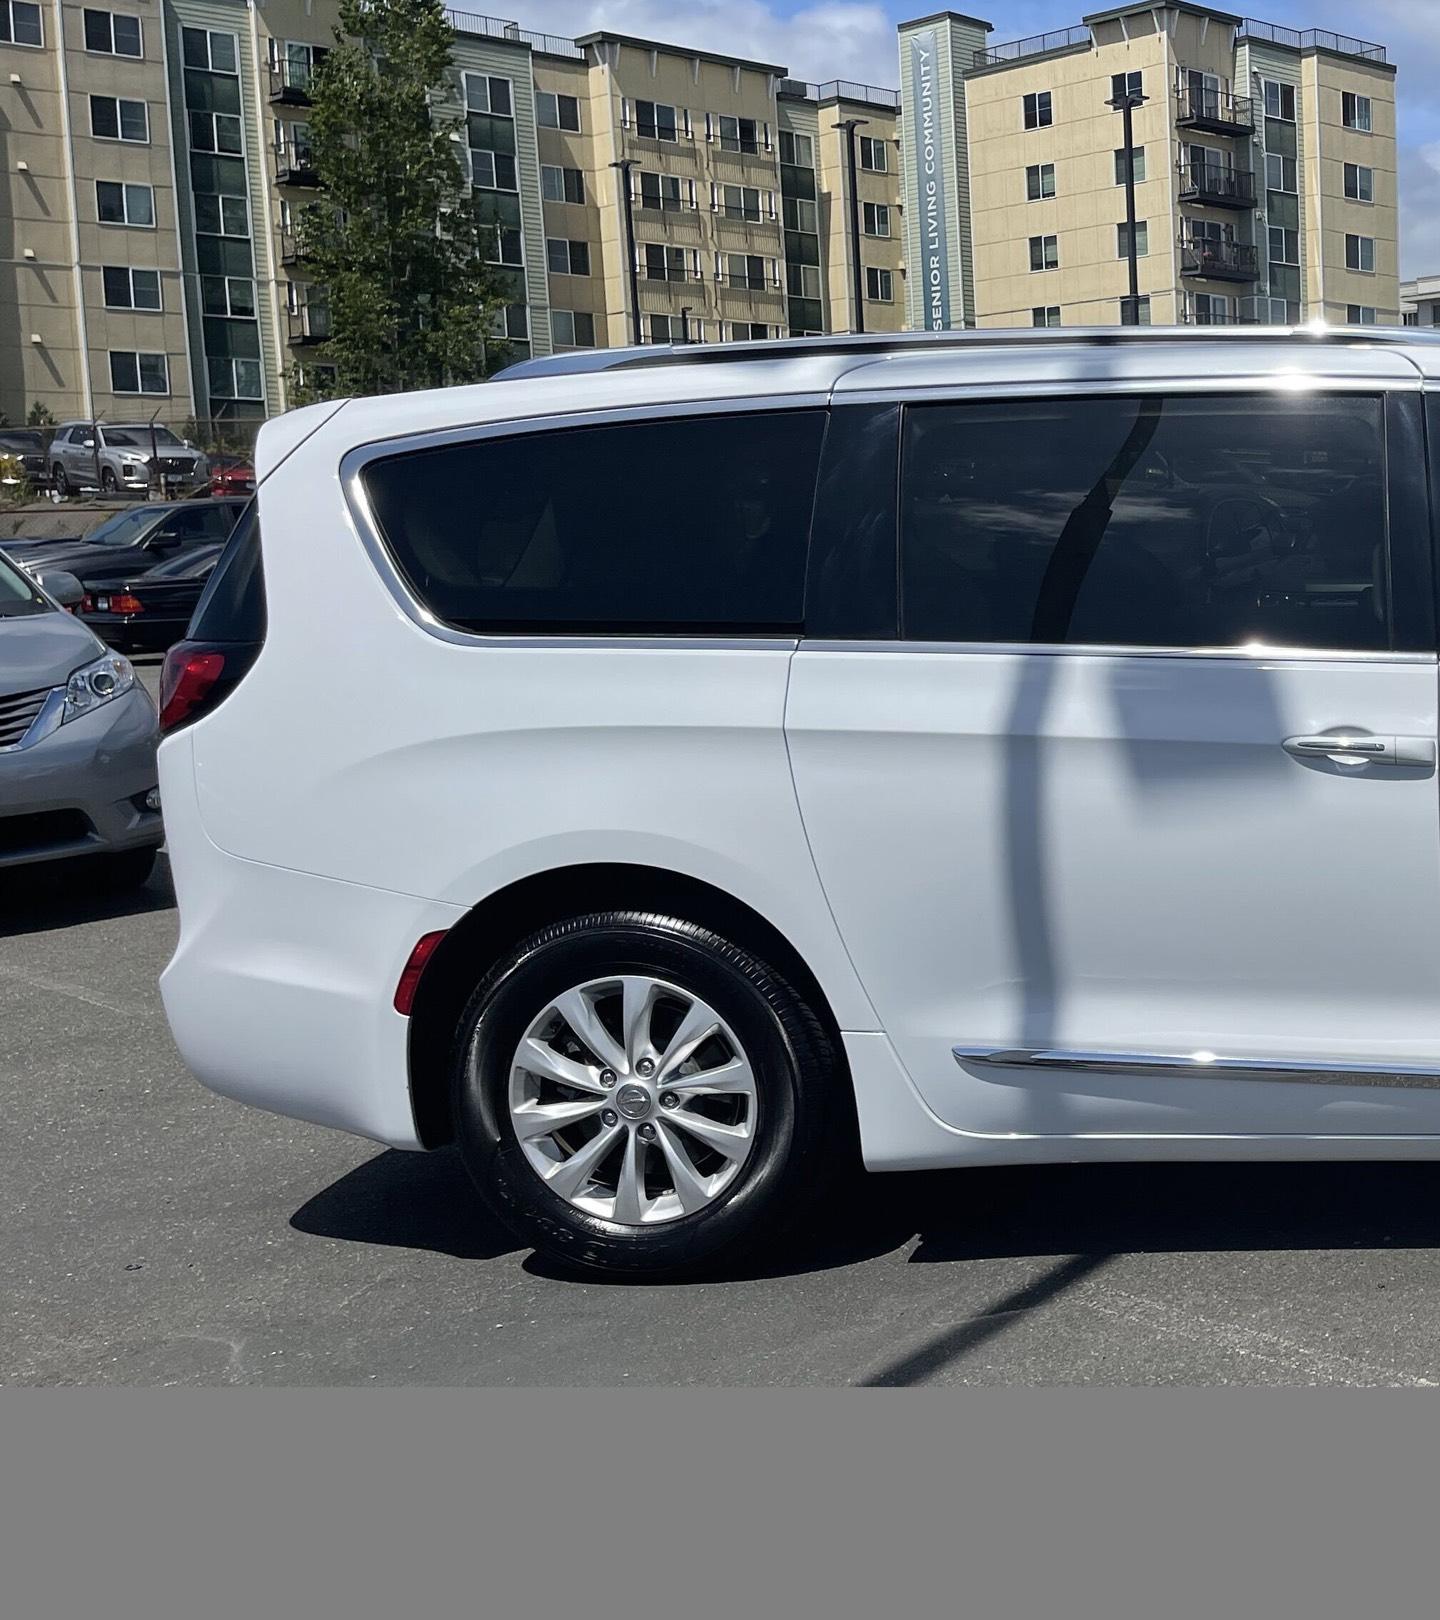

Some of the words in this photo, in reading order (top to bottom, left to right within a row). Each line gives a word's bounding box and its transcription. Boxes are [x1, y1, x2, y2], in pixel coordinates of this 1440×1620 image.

[918, 49, 936, 175] COMMUNITY
[925, 182, 940, 250] LIVING
[931, 255, 943, 331] SENIOR
